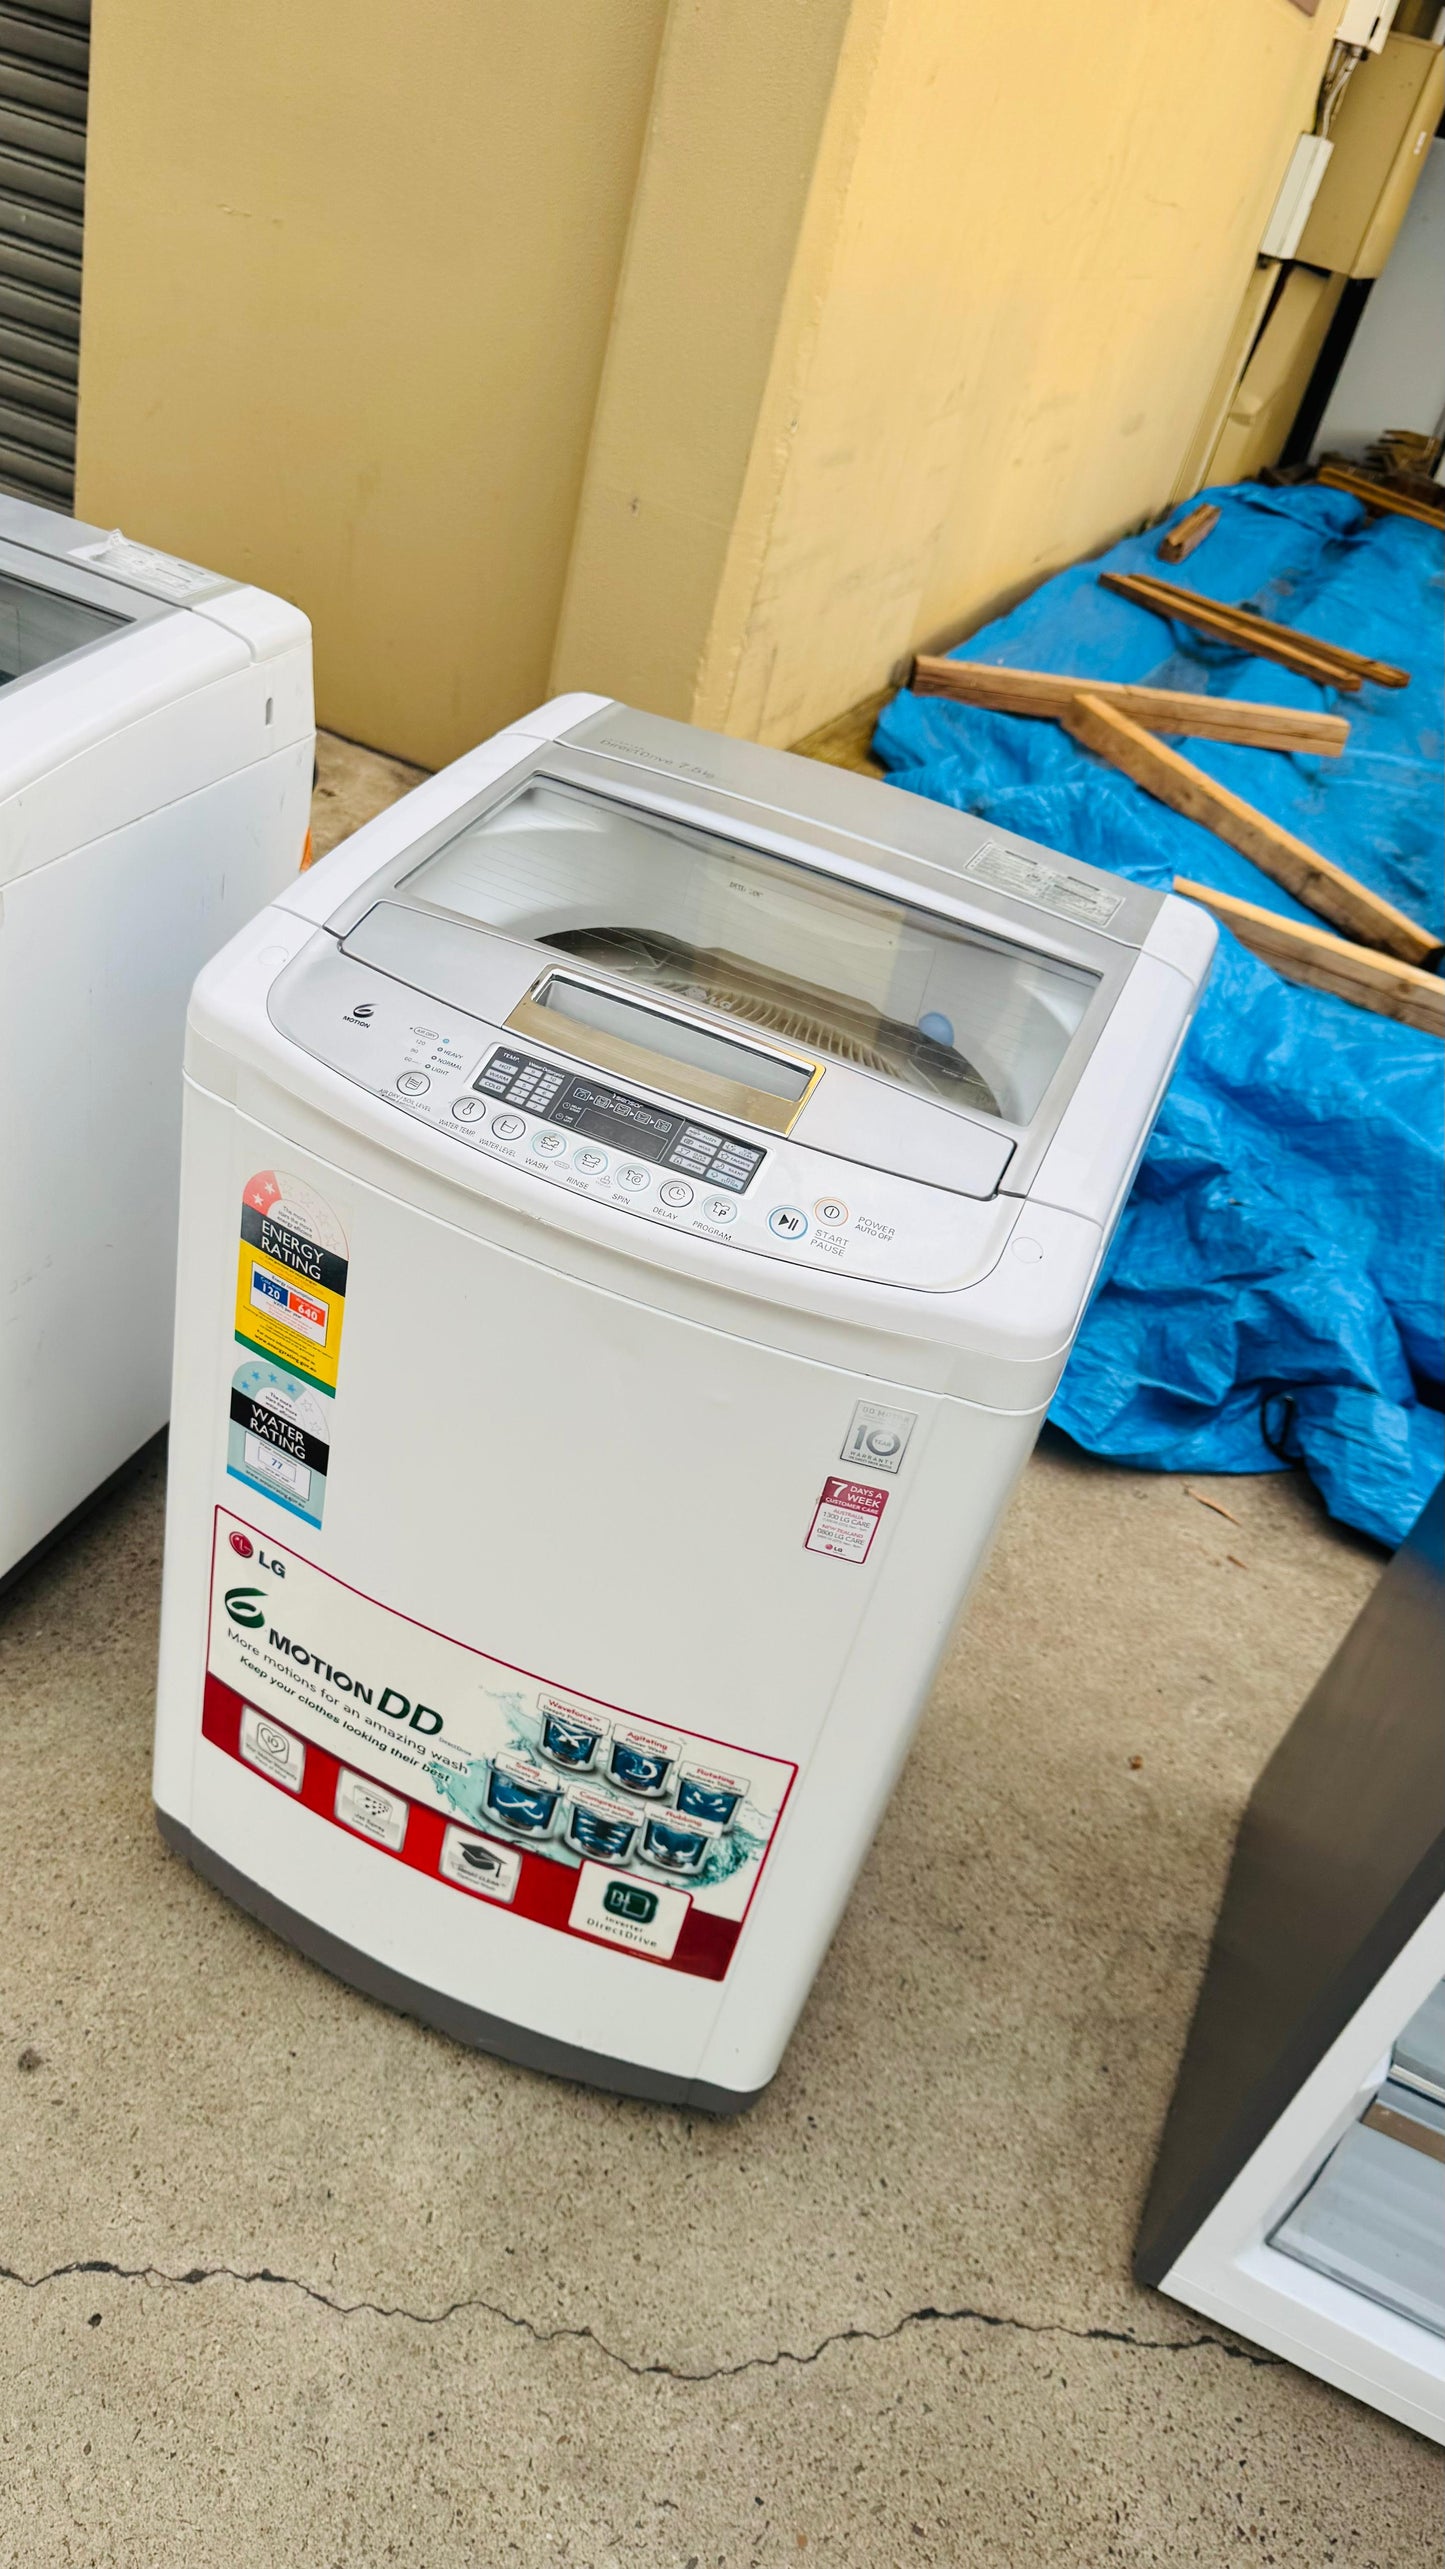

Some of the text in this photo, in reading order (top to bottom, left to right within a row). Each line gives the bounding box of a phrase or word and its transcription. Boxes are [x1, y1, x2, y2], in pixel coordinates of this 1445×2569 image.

[342, 1015, 371, 1029] MOTION
[444, 1049, 463, 1060] HEAVY
[431, 1066, 449, 1076] LIGHT
[437, 1058, 462, 1071] NORMAL
[498, 1063, 512, 1071] HOT
[489, 1071, 509, 1082] WARM
[484, 1081, 502, 1090] COLD
[415, 1101, 431, 1112] LEVEL
[438, 1118, 459, 1130] WATER
[478, 1138, 517, 1157] WATER LEVEL
[525, 1157, 549, 1171] WASH
[566, 1176, 589, 1190] RINSE
[611, 1193, 631, 1205] SPIN
[652, 1206, 678, 1221] DELAY
[692, 1220, 732, 1241] PROGRAM
[855, 1224, 893, 1241] AUTO OFF
[857, 1216, 896, 1236] POWER
[262, 1220, 324, 1264] ENERGY
[815, 1229, 849, 1247] START
[810, 1238, 845, 1257] PAUSE
[261, 1236, 321, 1280] RATING
[262, 1283, 280, 1300] 120
[297, 1304, 318, 1321] 640
[252, 1404, 305, 1446] WATER
[250, 1417, 306, 1460] RATING
[854, 1424, 901, 1457] 10
[874, 1438, 892, 1447] YEAR
[271, 1457, 283, 1470] 77
[850, 1451, 893, 1466] WARRANTY
[831, 1480, 848, 1498] 7
[850, 1485, 874, 1497] DAYS
[825, 1497, 879, 1515] CUSTOMER CARE
[847, 1493, 881, 1509] WEEK
[833, 1508, 864, 1520] AUSTRALIA
[851, 1520, 871, 1529] CARE
[817, 1527, 833, 1537] 0800
[845, 1536, 865, 1546] CARE
[836, 1528, 864, 1539] ZEALAND
[258, 1550, 286, 1579] LG
[268, 1628, 373, 1705] MOTION
[377, 1687, 444, 1736] DD
[227, 1627, 469, 1775] More motions for an amazing wash
[240, 1655, 450, 1782] Keep your clothes looking their best
[543, 1704, 603, 1732] Deeply Penetrates
[625, 1737, 667, 1754] Power Wash
[627, 1731, 668, 1751] Agitating
[505, 1764, 548, 1785] Delicate Care
[515, 1761, 540, 1777] Swing
[696, 1768, 735, 1786] Rotating
[579, 1790, 635, 1817] Compressing
[665, 1810, 703, 1827] Rubbing
[586, 1917, 658, 1948] DirectDrive
[605, 1915, 643, 1933] Inverter
